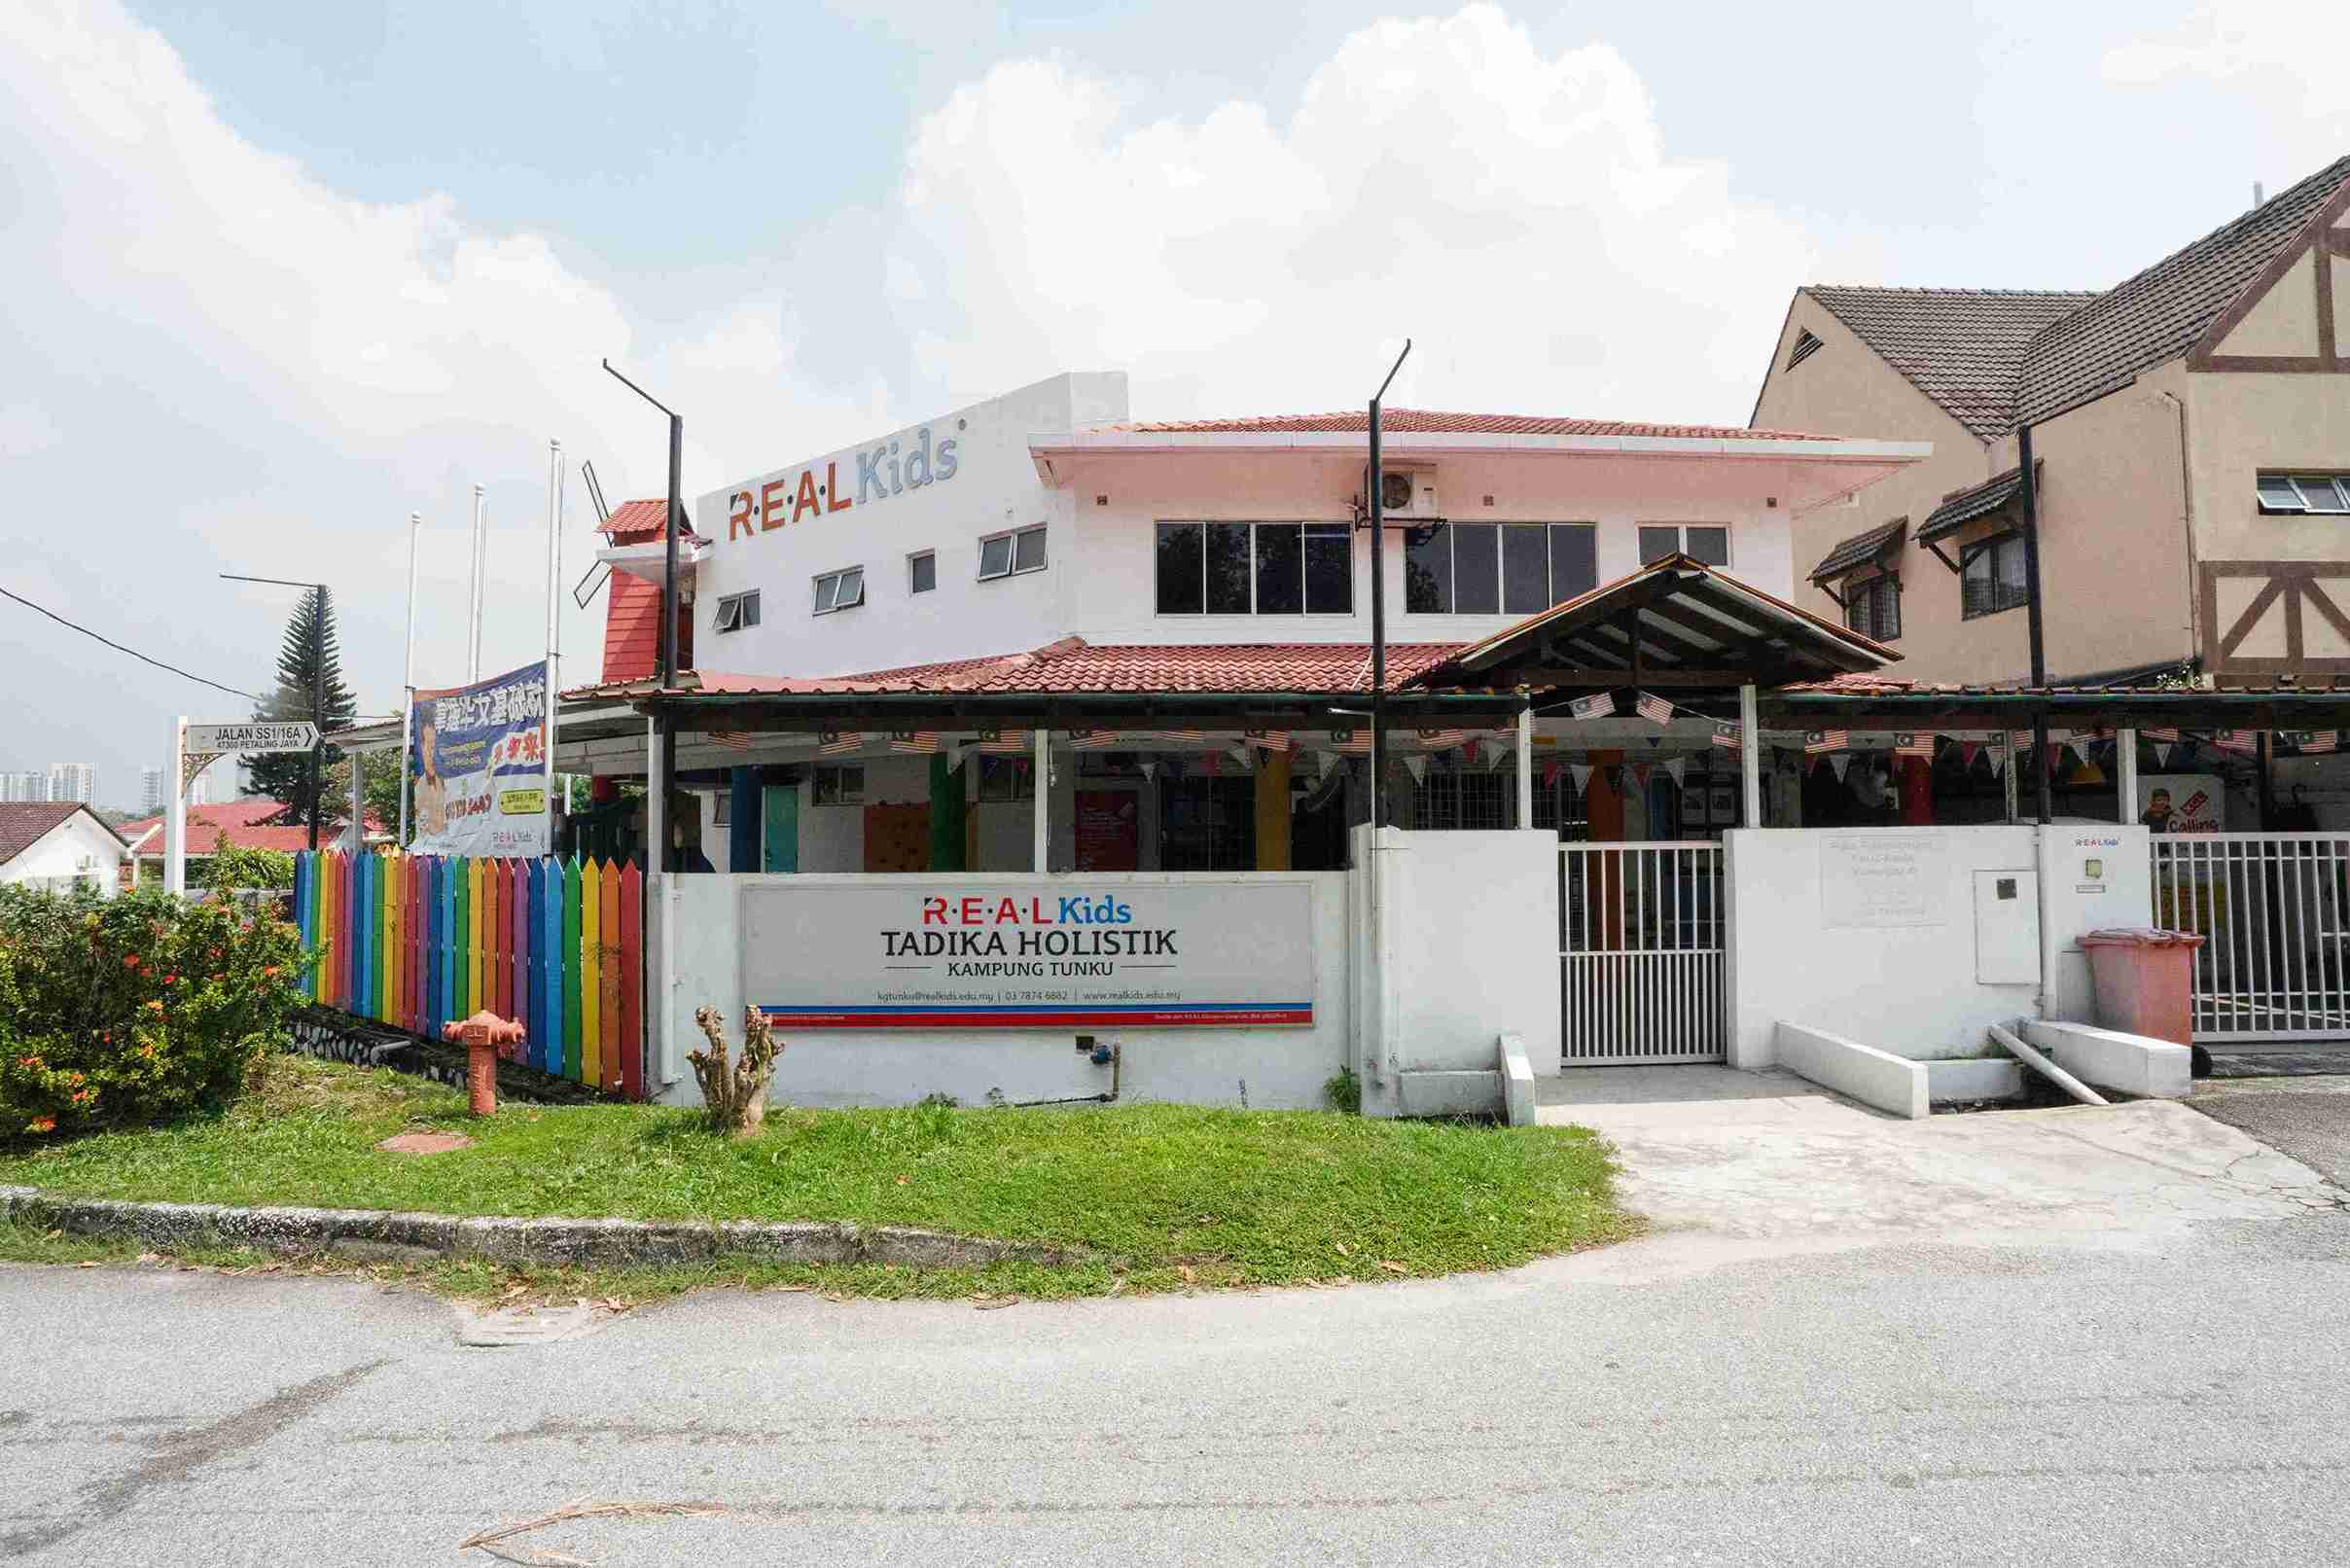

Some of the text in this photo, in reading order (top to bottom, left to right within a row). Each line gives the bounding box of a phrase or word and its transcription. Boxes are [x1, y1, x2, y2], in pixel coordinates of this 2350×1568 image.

[215, 727, 301, 740] JALAN SS1/16A
[279, 739, 299, 748] JAYA
[881, 930, 1178, 956] TADIKA HOLISTIK
[947, 961, 1114, 977] KAMPUNG TUNKU
